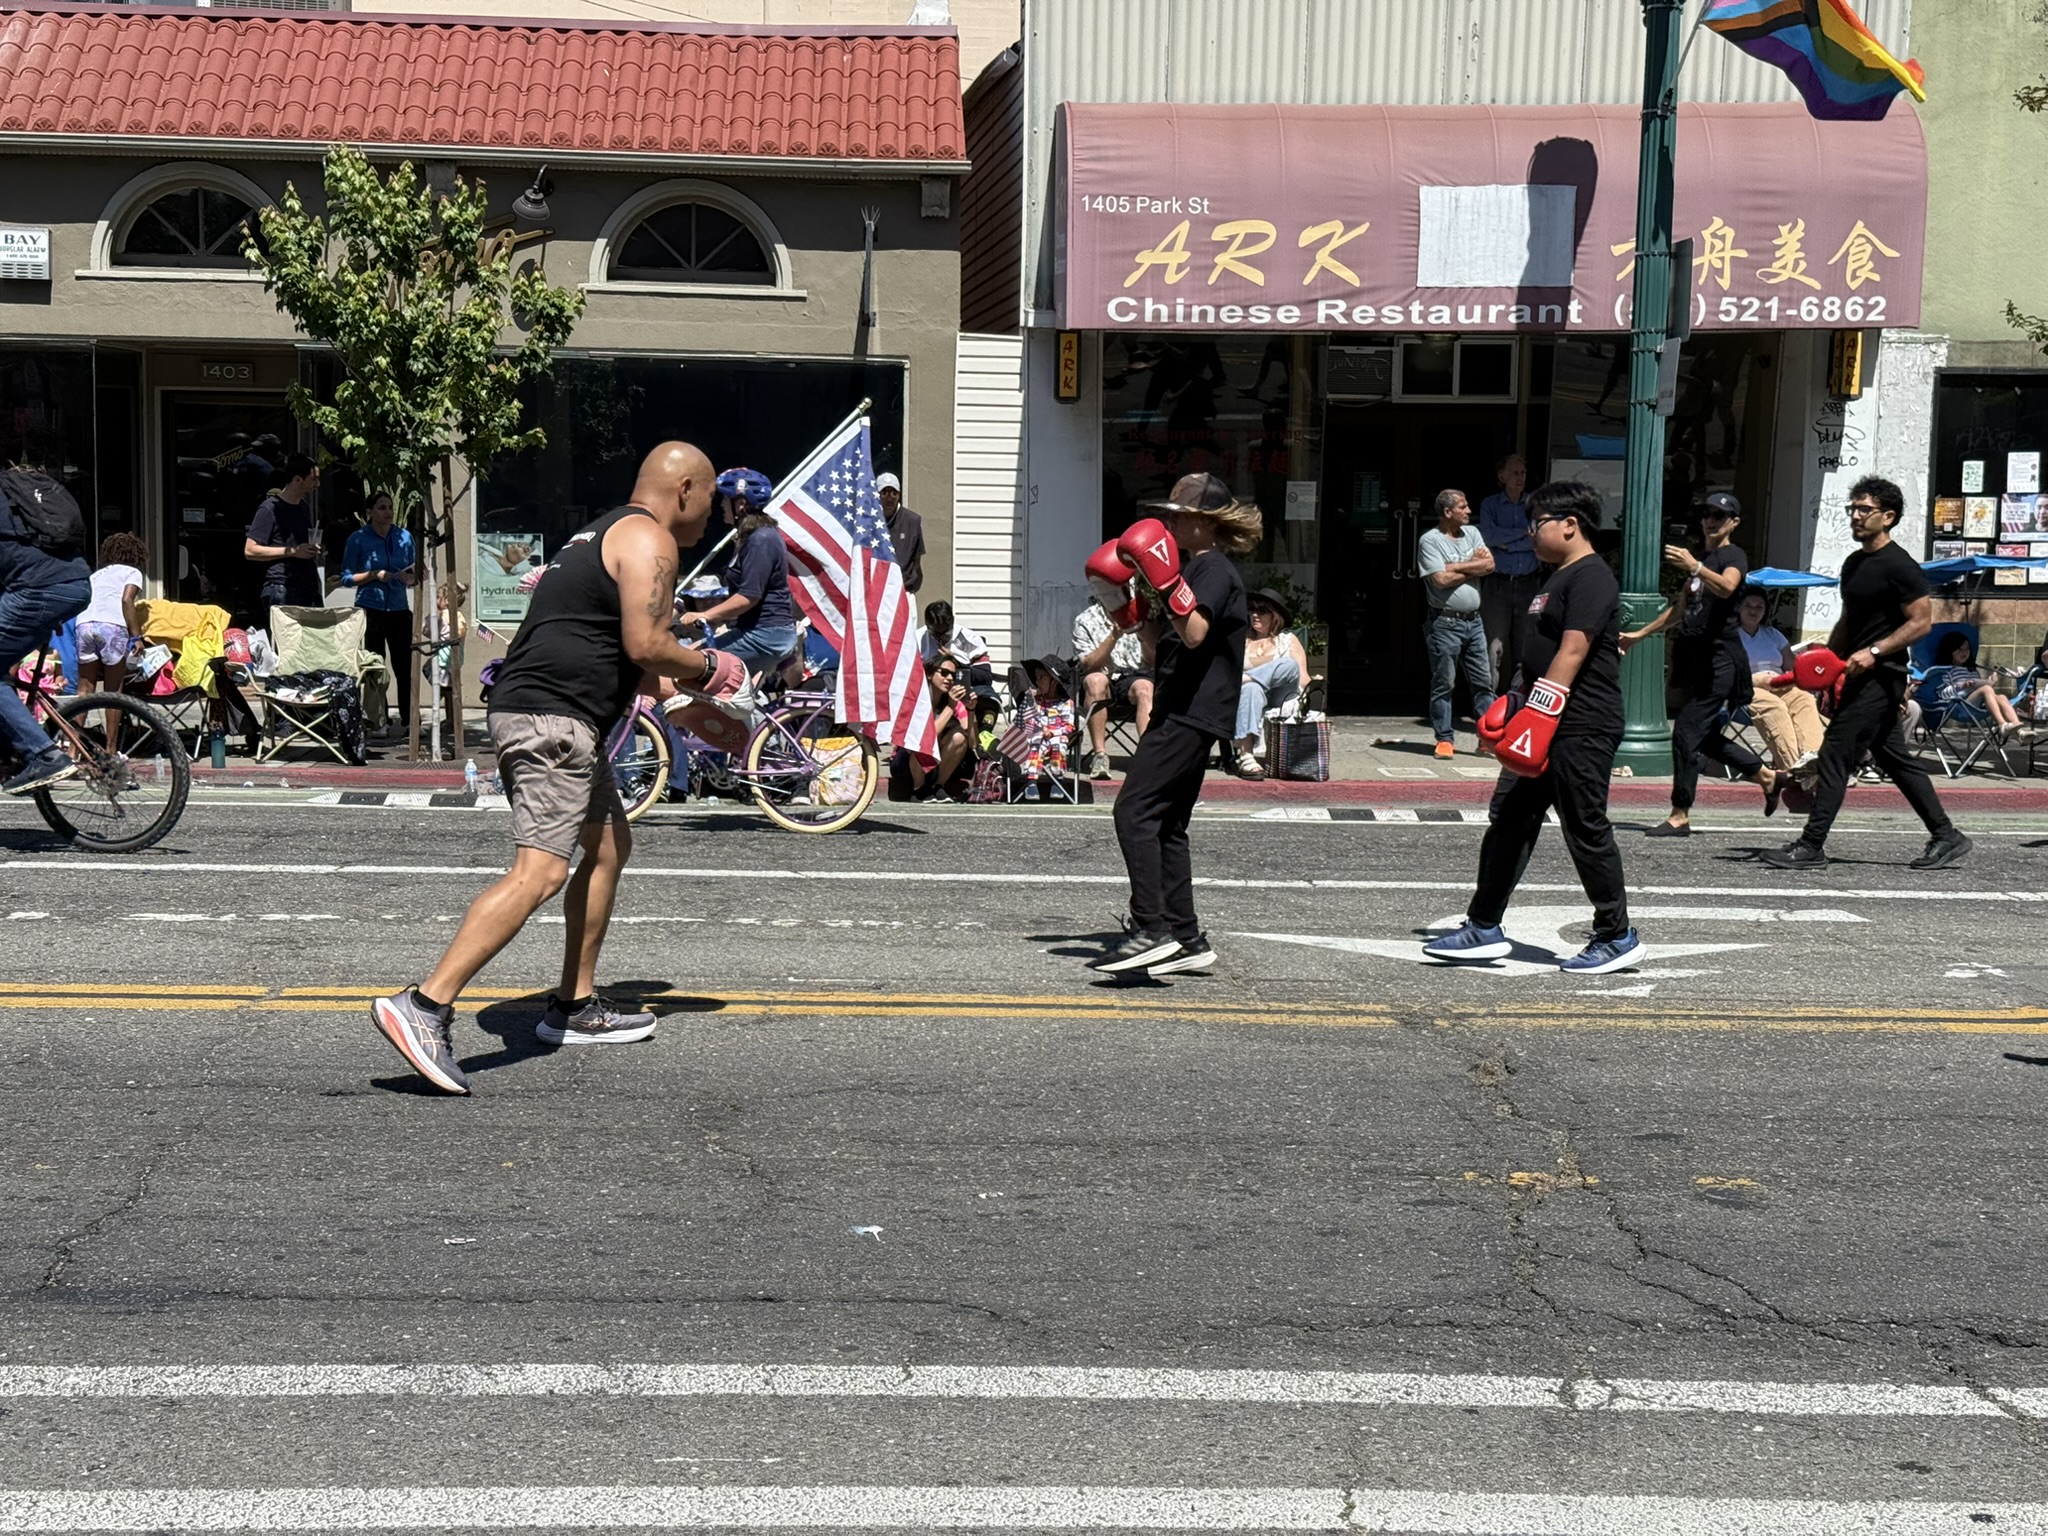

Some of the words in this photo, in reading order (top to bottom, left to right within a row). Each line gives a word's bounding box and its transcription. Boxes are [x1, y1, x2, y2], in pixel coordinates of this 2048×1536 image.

[1081, 195, 1130, 213] 1405
[1136, 196, 1183, 214] Park
[1188, 197, 1210, 214] St
[4, 234, 41, 245] BAY
[1123, 219, 1370, 288] ARK
[1106, 296, 1301, 324] Chinese
[1316, 298, 1583, 325] Restaurant
[1718, 295, 1887, 323] 521-6862
[203, 365, 250, 379] 1403
[1063, 339, 1075, 390] ARK
[1530, 689, 1553, 708] TITLE
